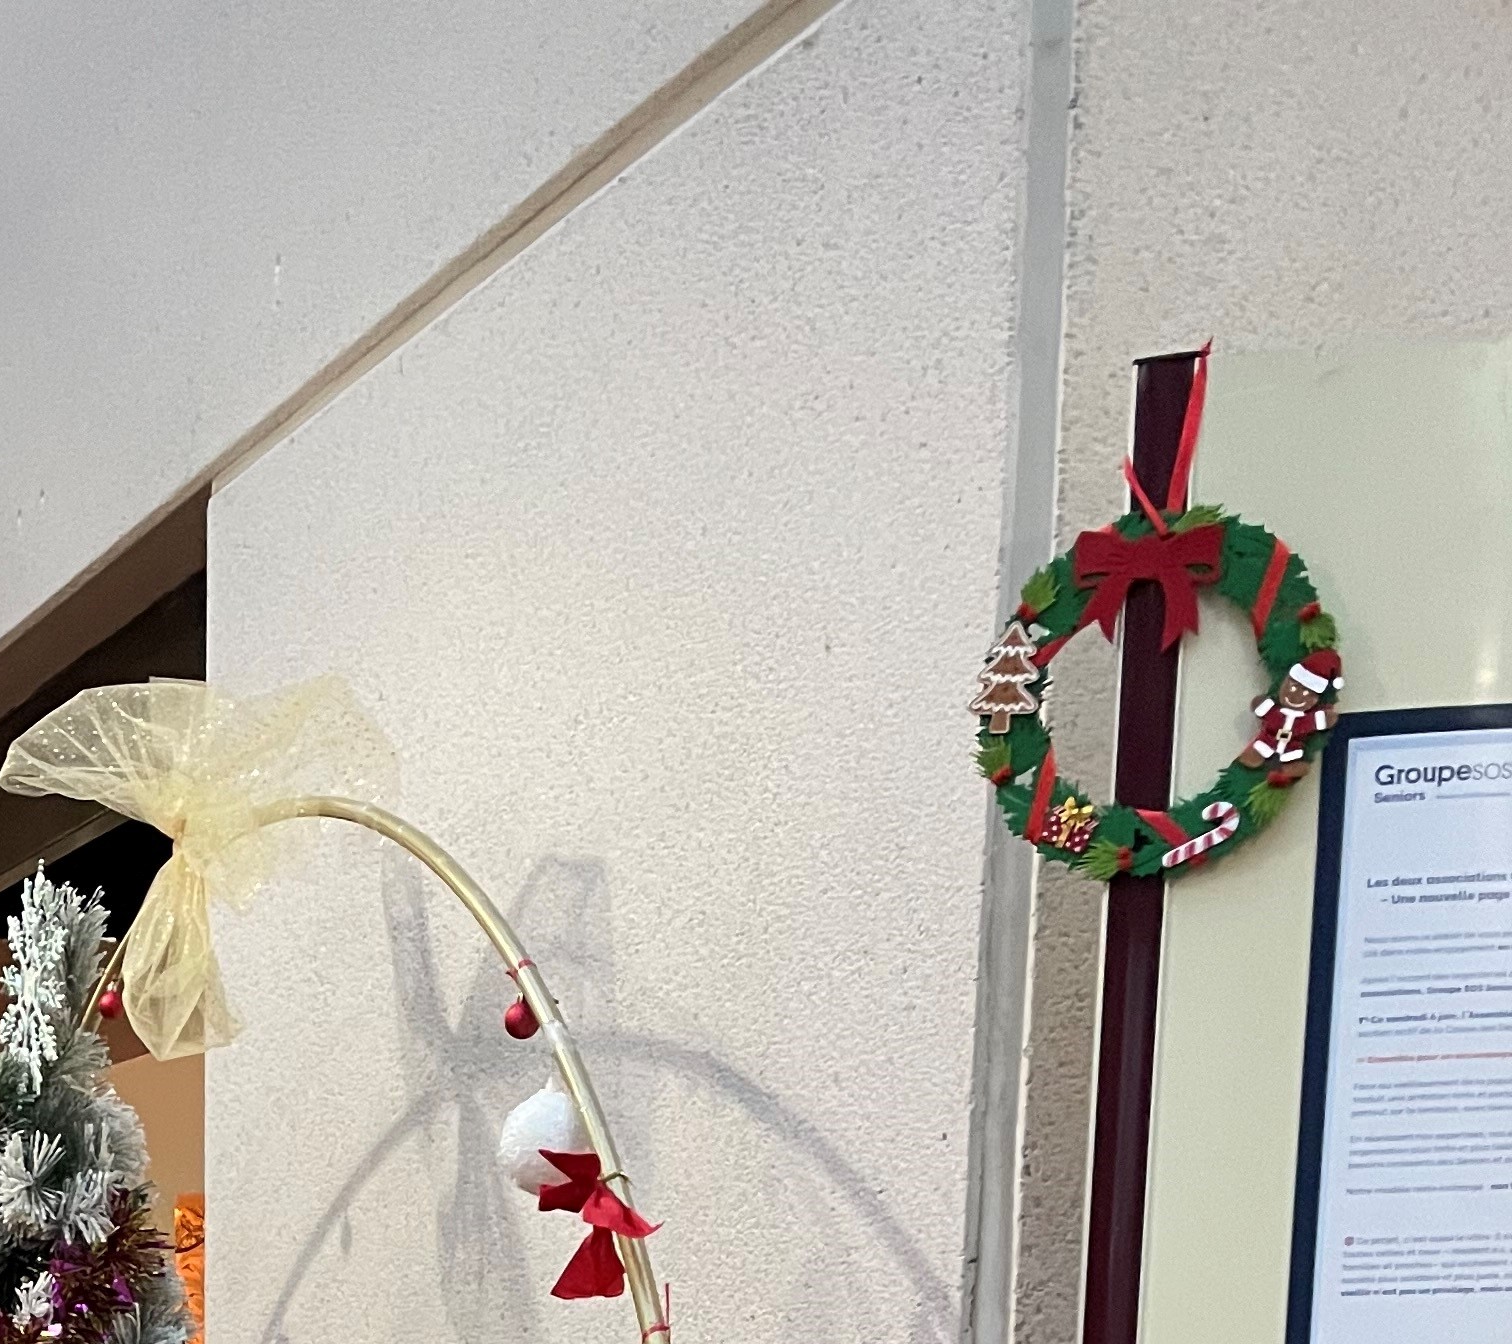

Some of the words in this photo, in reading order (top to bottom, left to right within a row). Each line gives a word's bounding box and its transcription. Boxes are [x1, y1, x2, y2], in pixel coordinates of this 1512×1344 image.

[1374, 790, 1426, 804] Seniors
[1366, 877, 1389, 889] Les
[1391, 876, 1422, 887] deux
[1391, 893, 1416, 905] Une
[1418, 890, 1476, 903] nouvelle
